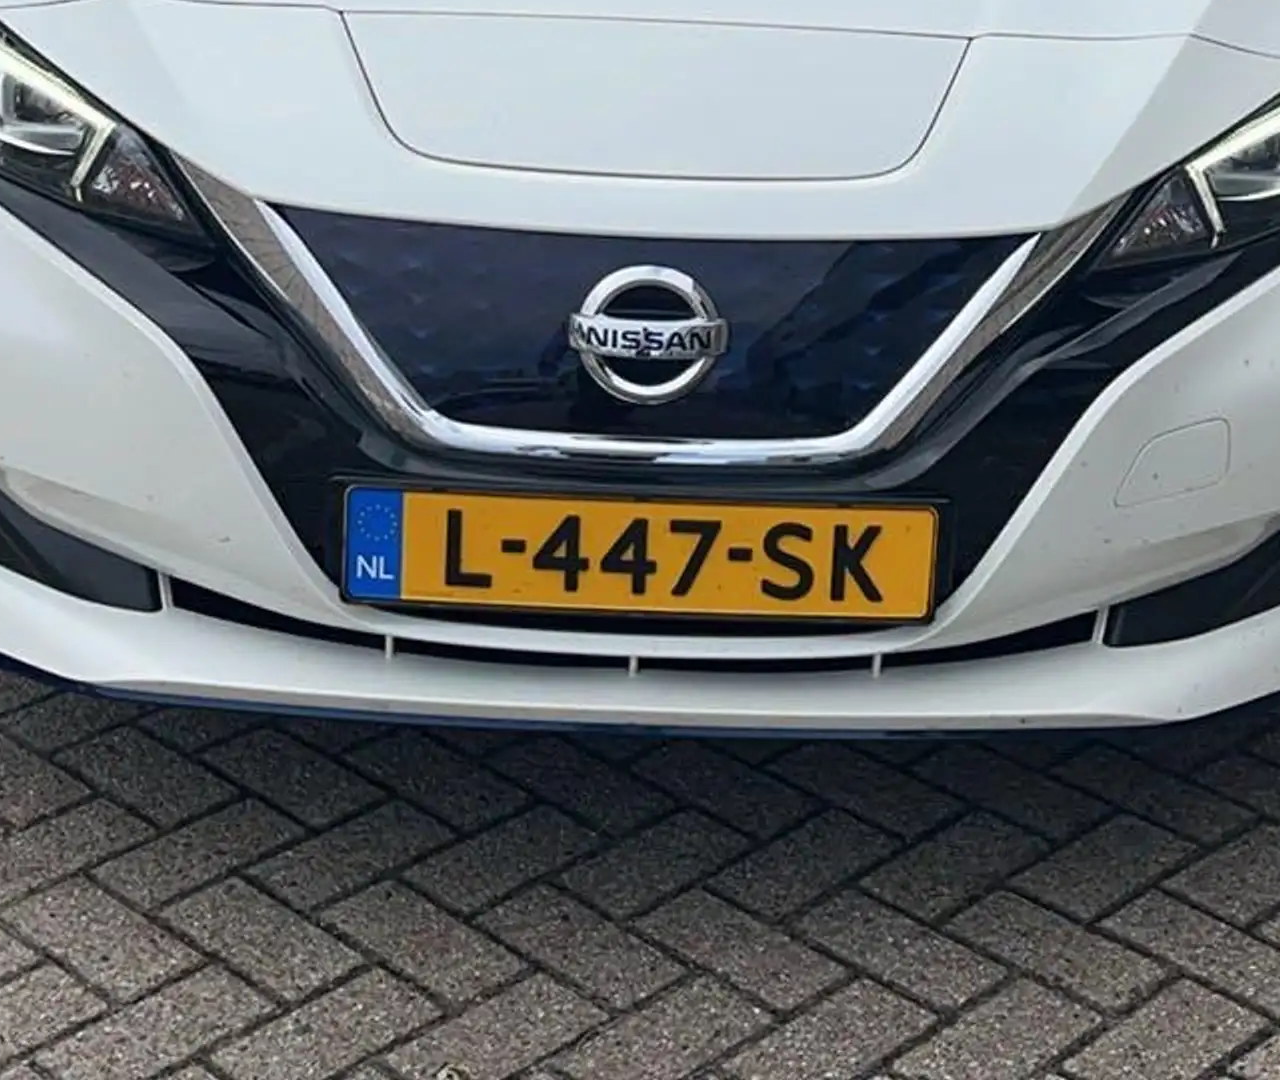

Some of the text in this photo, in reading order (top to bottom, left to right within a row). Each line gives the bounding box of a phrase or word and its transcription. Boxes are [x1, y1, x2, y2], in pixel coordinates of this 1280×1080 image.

[586, 327, 712, 352] NISSAN
[356, 555, 394, 580] NL
[445, 509, 883, 602] L-447-SK
